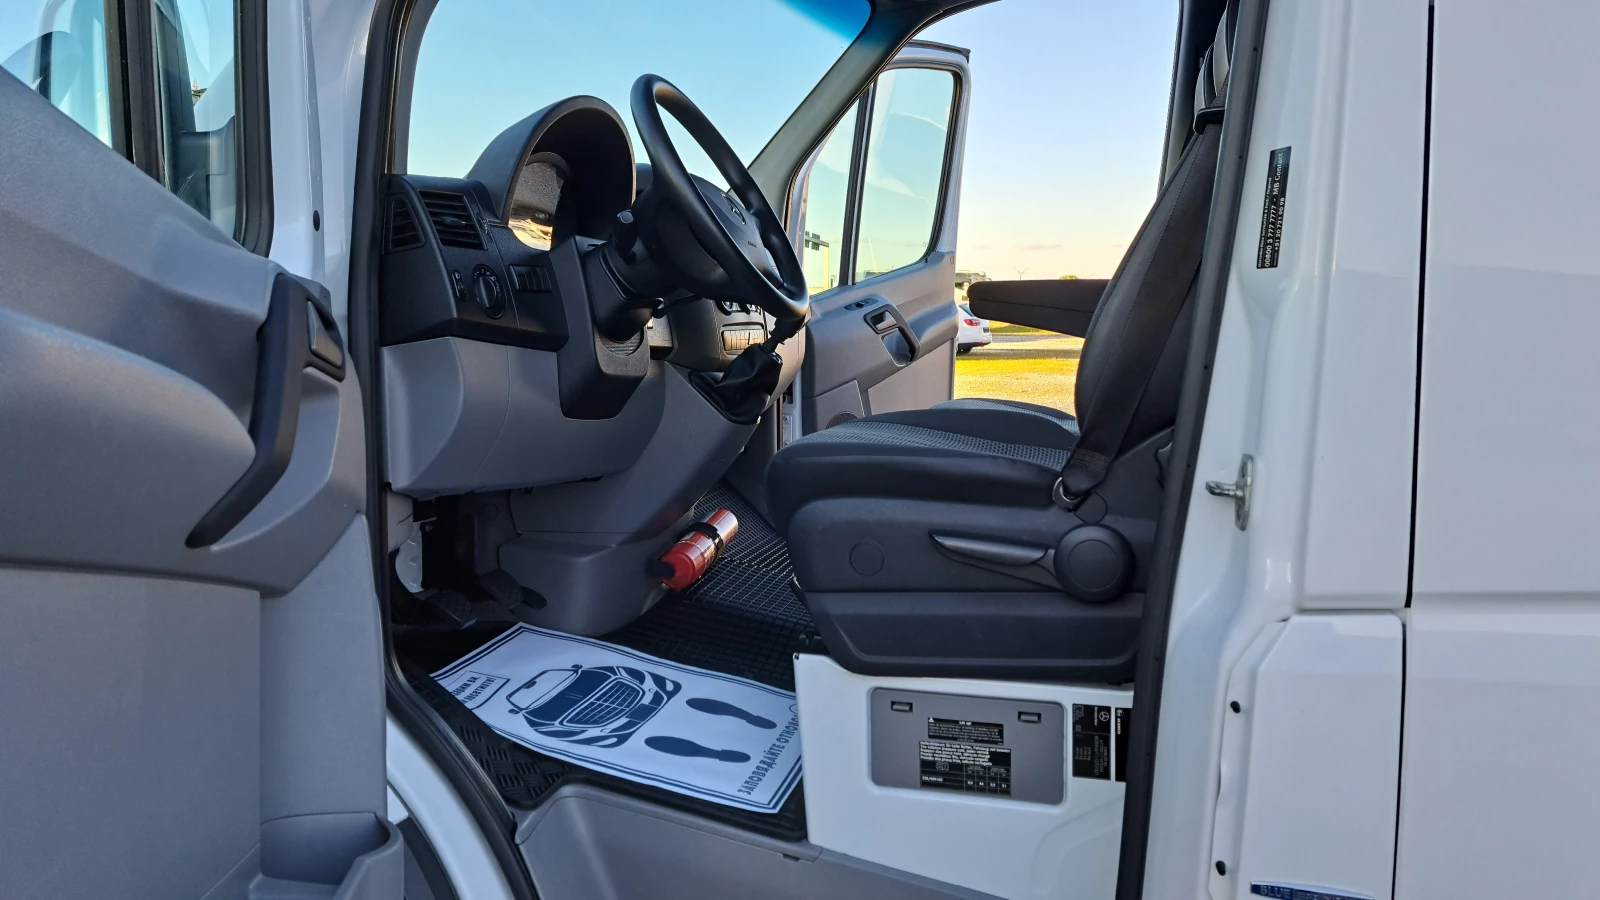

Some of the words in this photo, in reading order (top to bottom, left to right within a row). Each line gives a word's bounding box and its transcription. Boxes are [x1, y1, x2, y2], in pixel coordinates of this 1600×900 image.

[1275, 153, 1283, 180] Contact
[1273, 182, 1280, 195] MB
[1269, 205, 1277, 222] 7777
[1276, 229, 1281, 237] 20
[1280, 197, 1285, 205] 98
[1264, 245, 1272, 267] 00800
[737, 743, 786, 795] ЗАПОВЯДАЙТЕ
